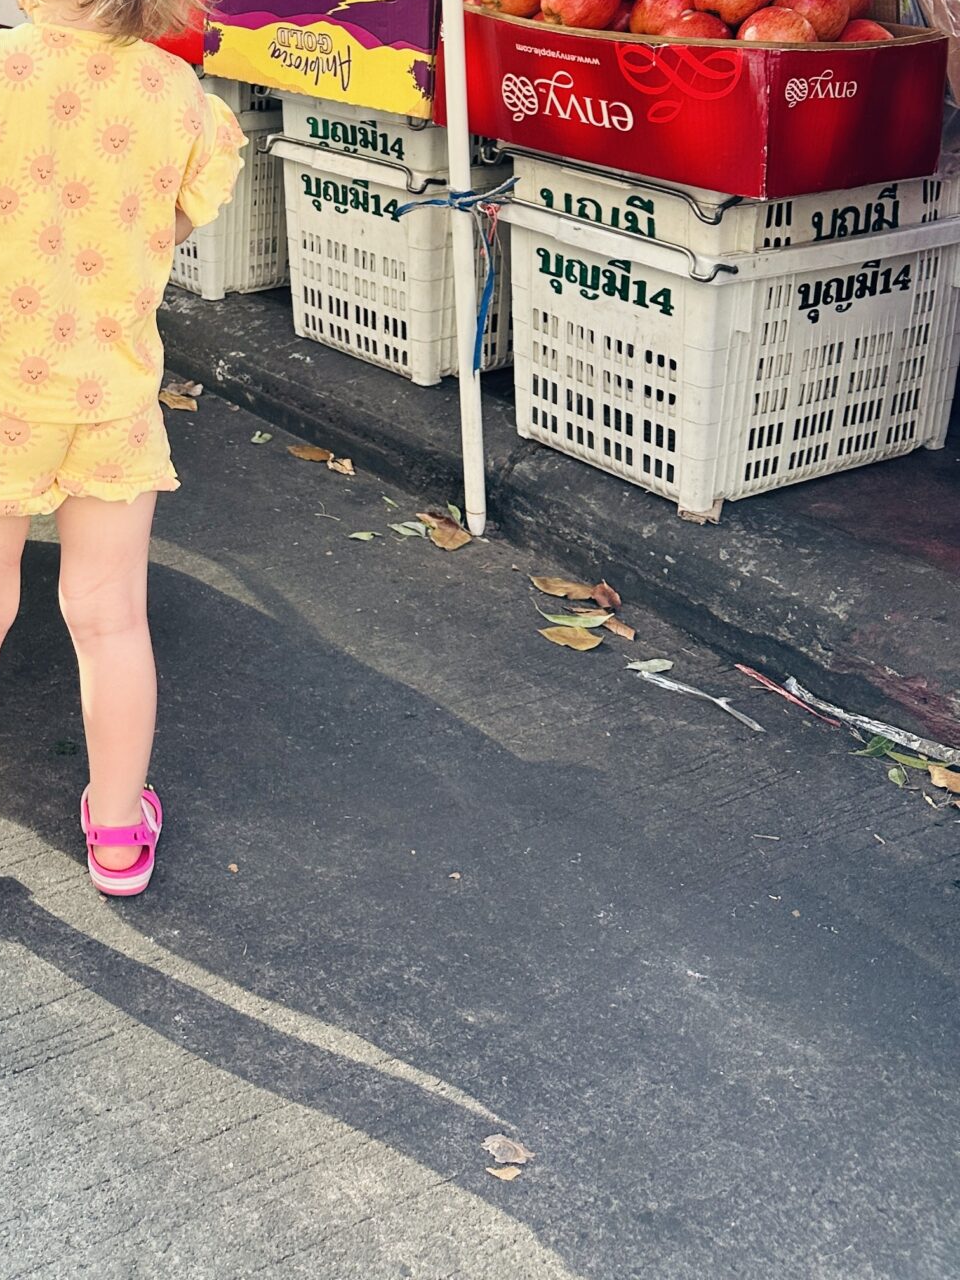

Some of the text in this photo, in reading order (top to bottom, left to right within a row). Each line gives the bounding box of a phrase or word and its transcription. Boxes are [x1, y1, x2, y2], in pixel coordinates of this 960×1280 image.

[277, 26, 333, 55] GOLD
[515, 43, 601, 66] www.envyapple.com
[268, 41, 352, 91] Ambrosia
[808, 69, 858, 99] envy
[534, 70, 634, 132] envy
[301, 173, 400, 222] บุญมี14
[536, 247, 675, 316] บุญมี14
[797, 258, 912, 324] บุญมี14
